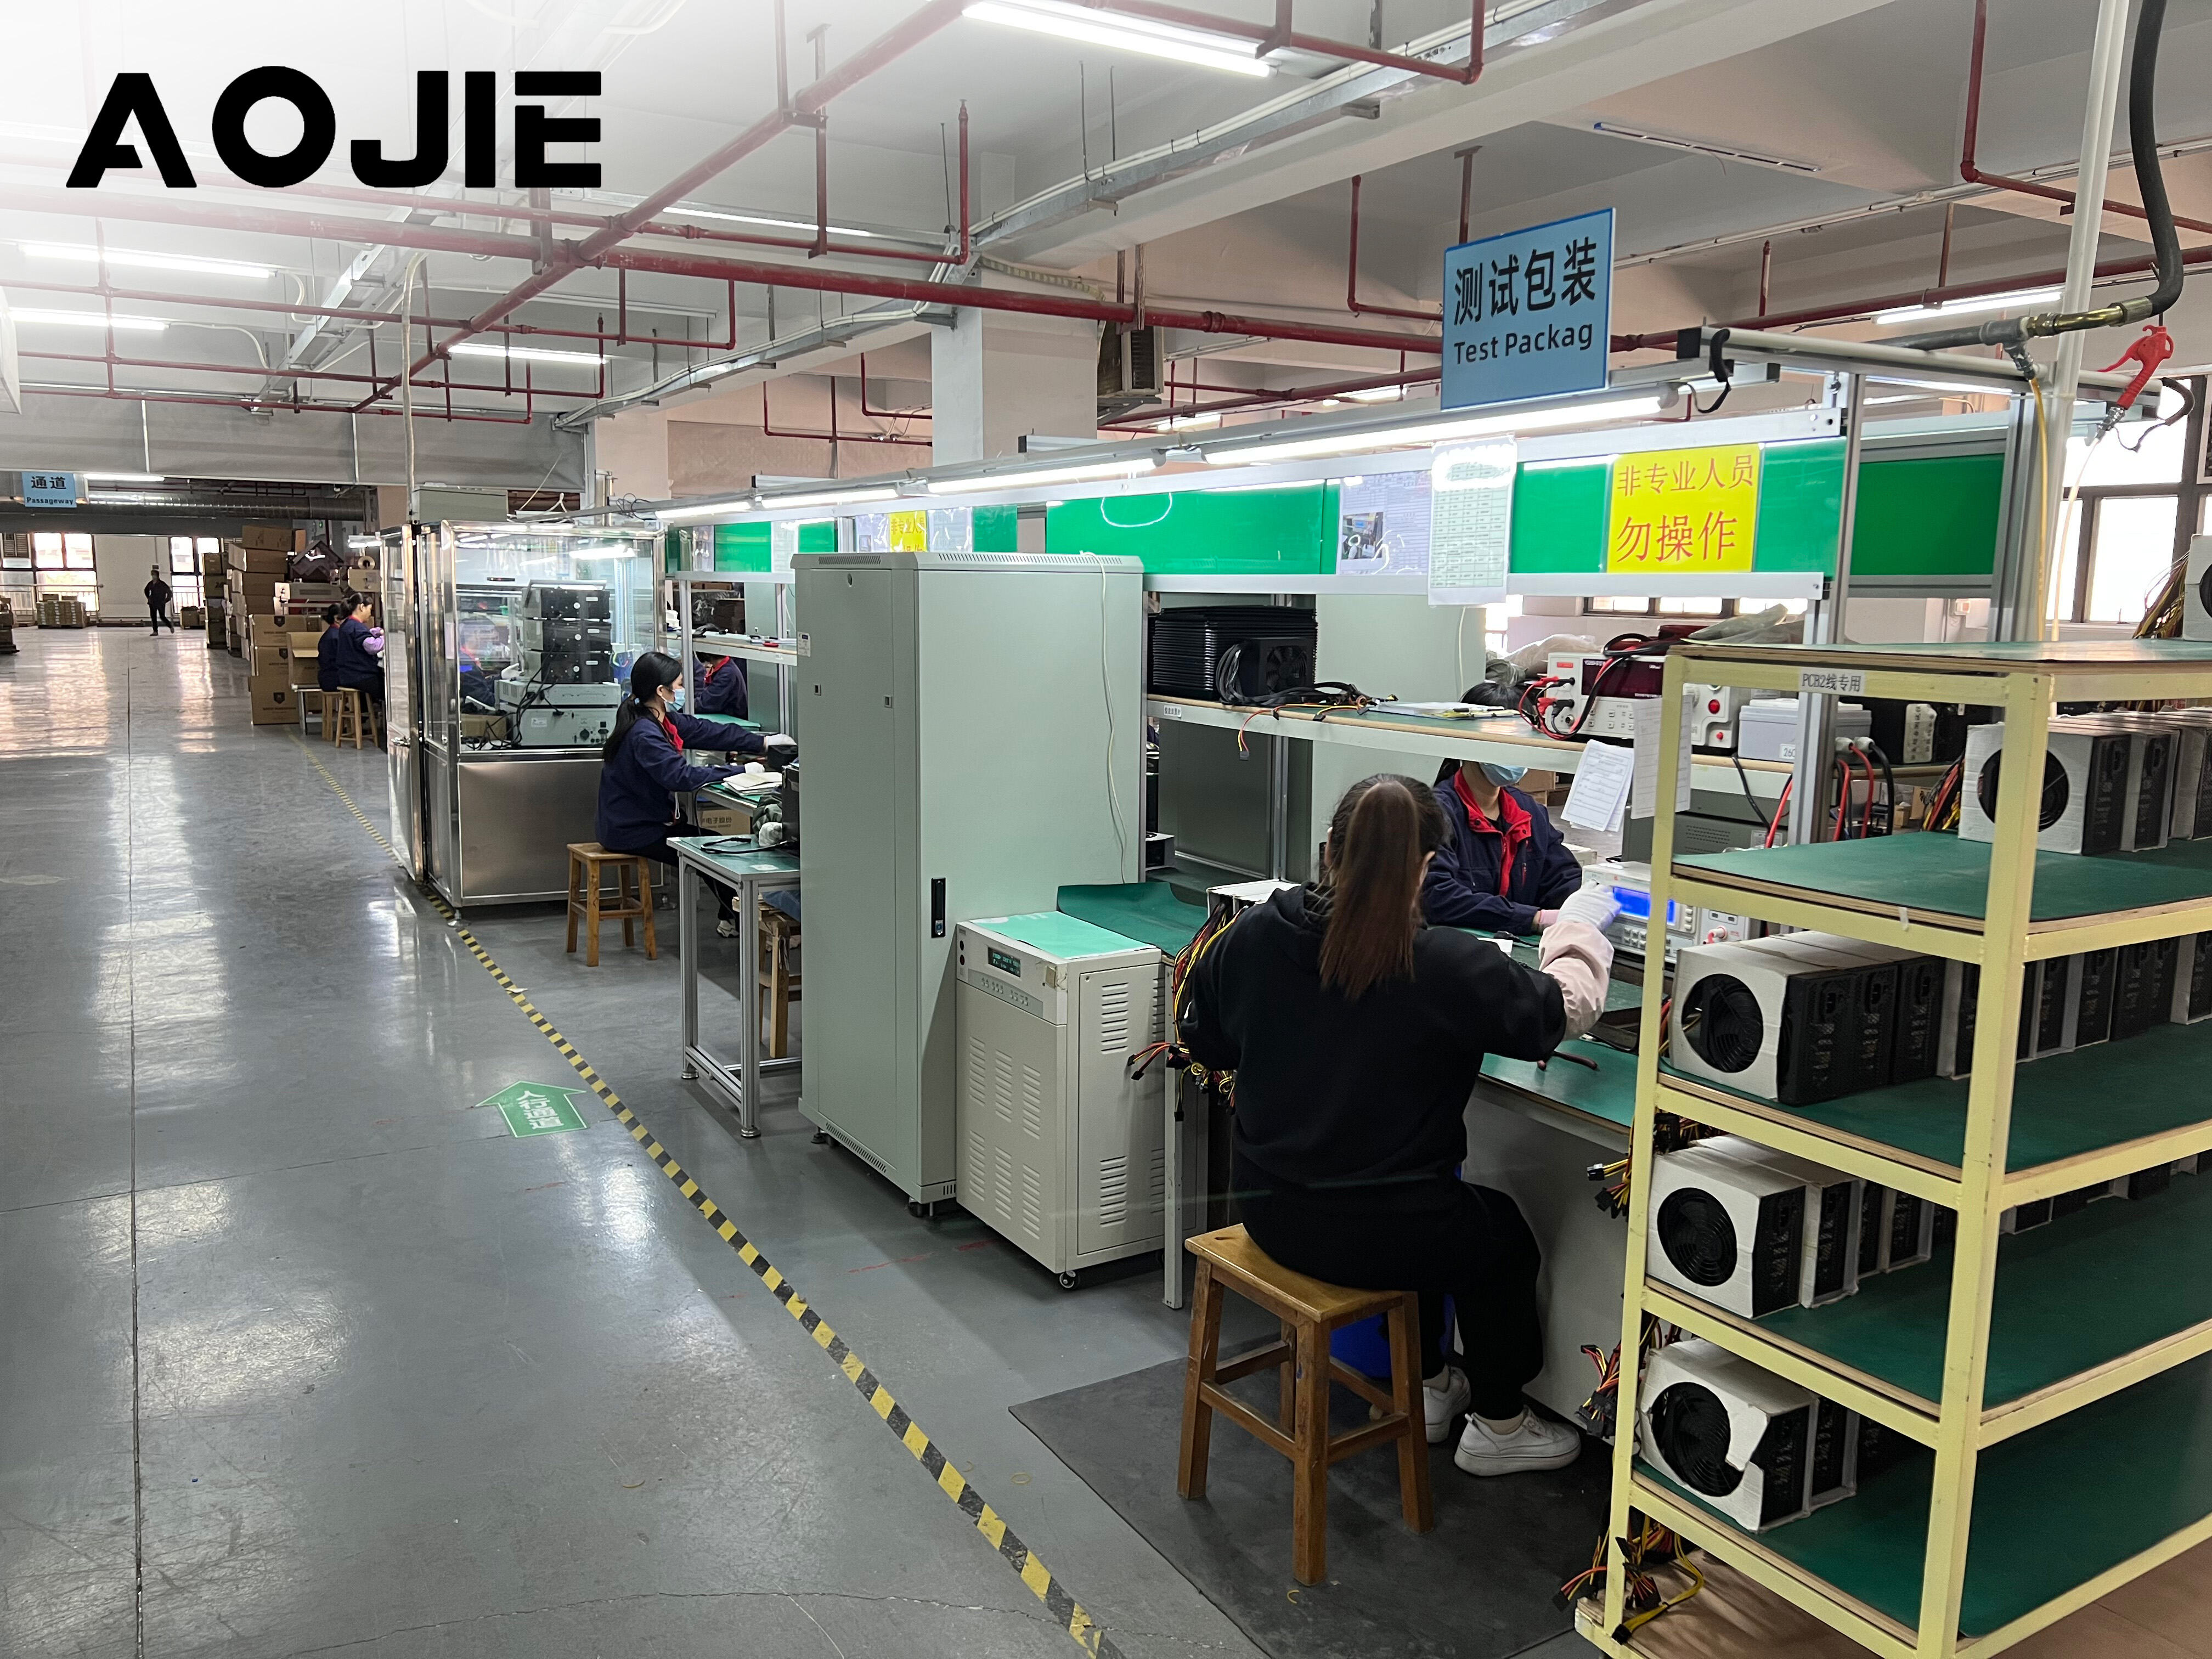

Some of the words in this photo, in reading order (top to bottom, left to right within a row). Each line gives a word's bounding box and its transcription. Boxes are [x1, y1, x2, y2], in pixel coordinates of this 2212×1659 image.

[1453, 236, 1598, 325] 测试包装
[1454, 336, 1499, 365] Test
[1505, 323, 1593, 358] Packag
[31, 476, 67, 490] 通道
[1617, 454, 1753, 497] 非专业人员
[26, 496, 74, 505] Passageway
[1616, 511, 1738, 563] 勿操作
[516, 1090, 564, 1130] 人行通道
